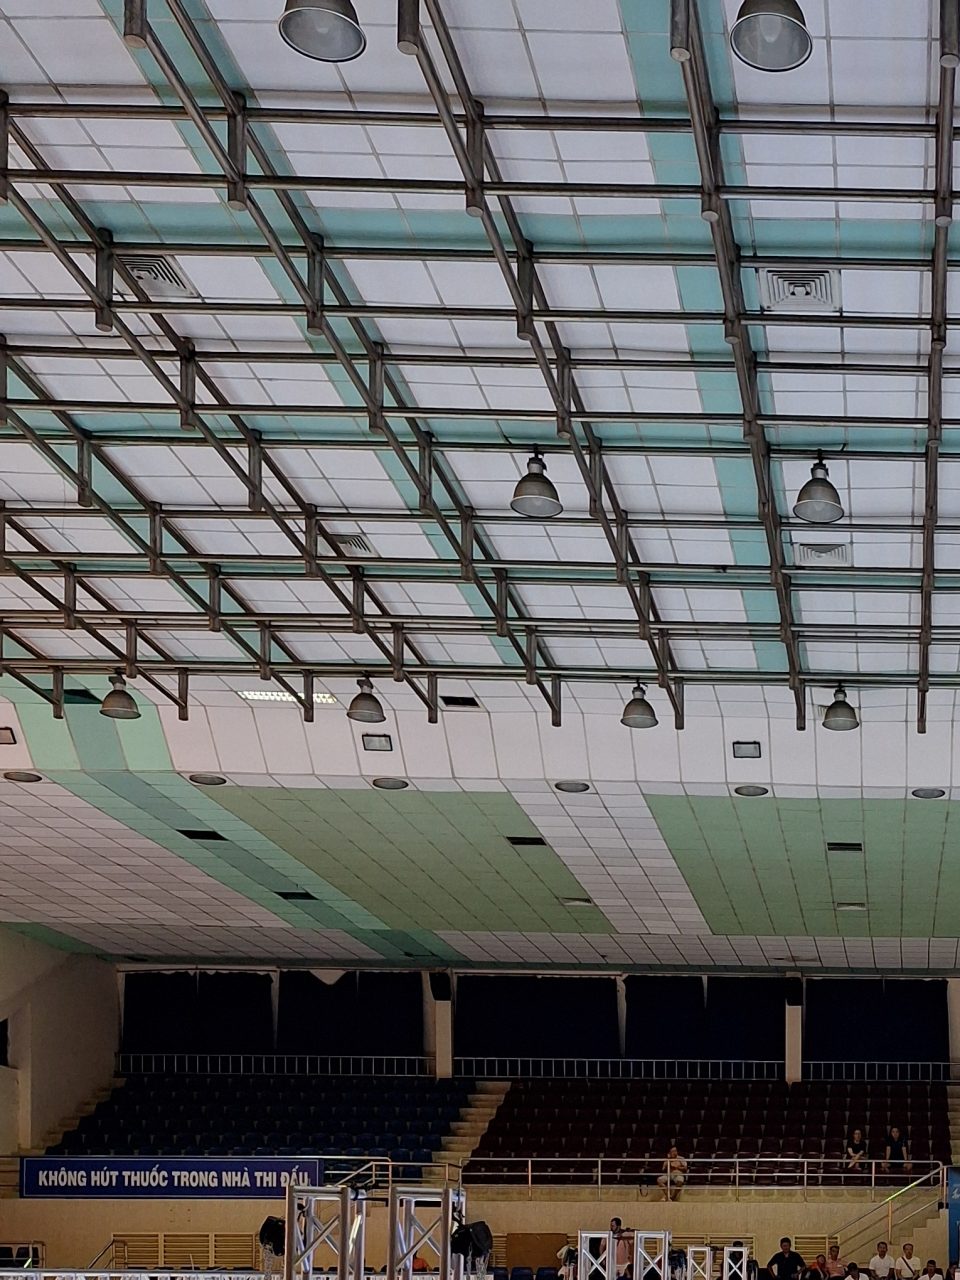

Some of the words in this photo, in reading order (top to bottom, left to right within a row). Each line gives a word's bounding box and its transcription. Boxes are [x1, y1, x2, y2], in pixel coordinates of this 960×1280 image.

[38, 1167, 87, 1187] KHÔNG
[90, 1166, 119, 1187] HÚT
[122, 1164, 168, 1187] THUỐC
[171, 1171, 218, 1187] TRONG
[222, 1168, 250, 1187] NHÀ
[254, 1171, 276, 1187] THI
